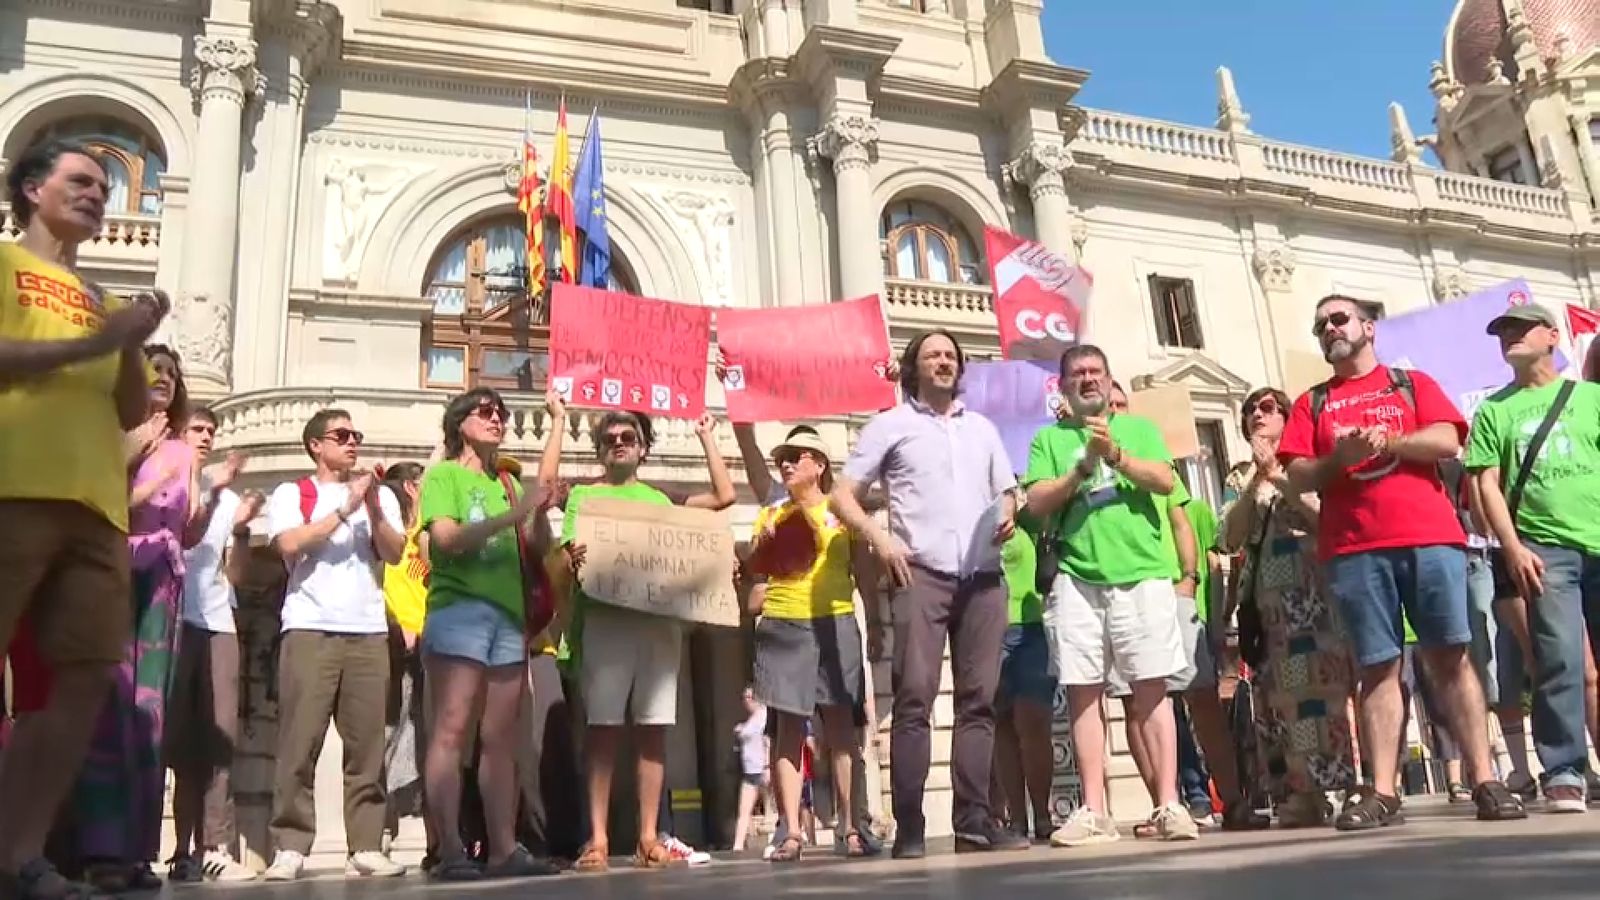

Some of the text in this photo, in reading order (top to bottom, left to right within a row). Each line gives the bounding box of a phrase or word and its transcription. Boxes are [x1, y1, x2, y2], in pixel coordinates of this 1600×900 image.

[18, 292, 104, 329] educac
[603, 295, 709, 339] DEFENSA
[594, 520, 721, 553] EL NOSTRE
[613, 551, 698, 577] ALUMNAT
